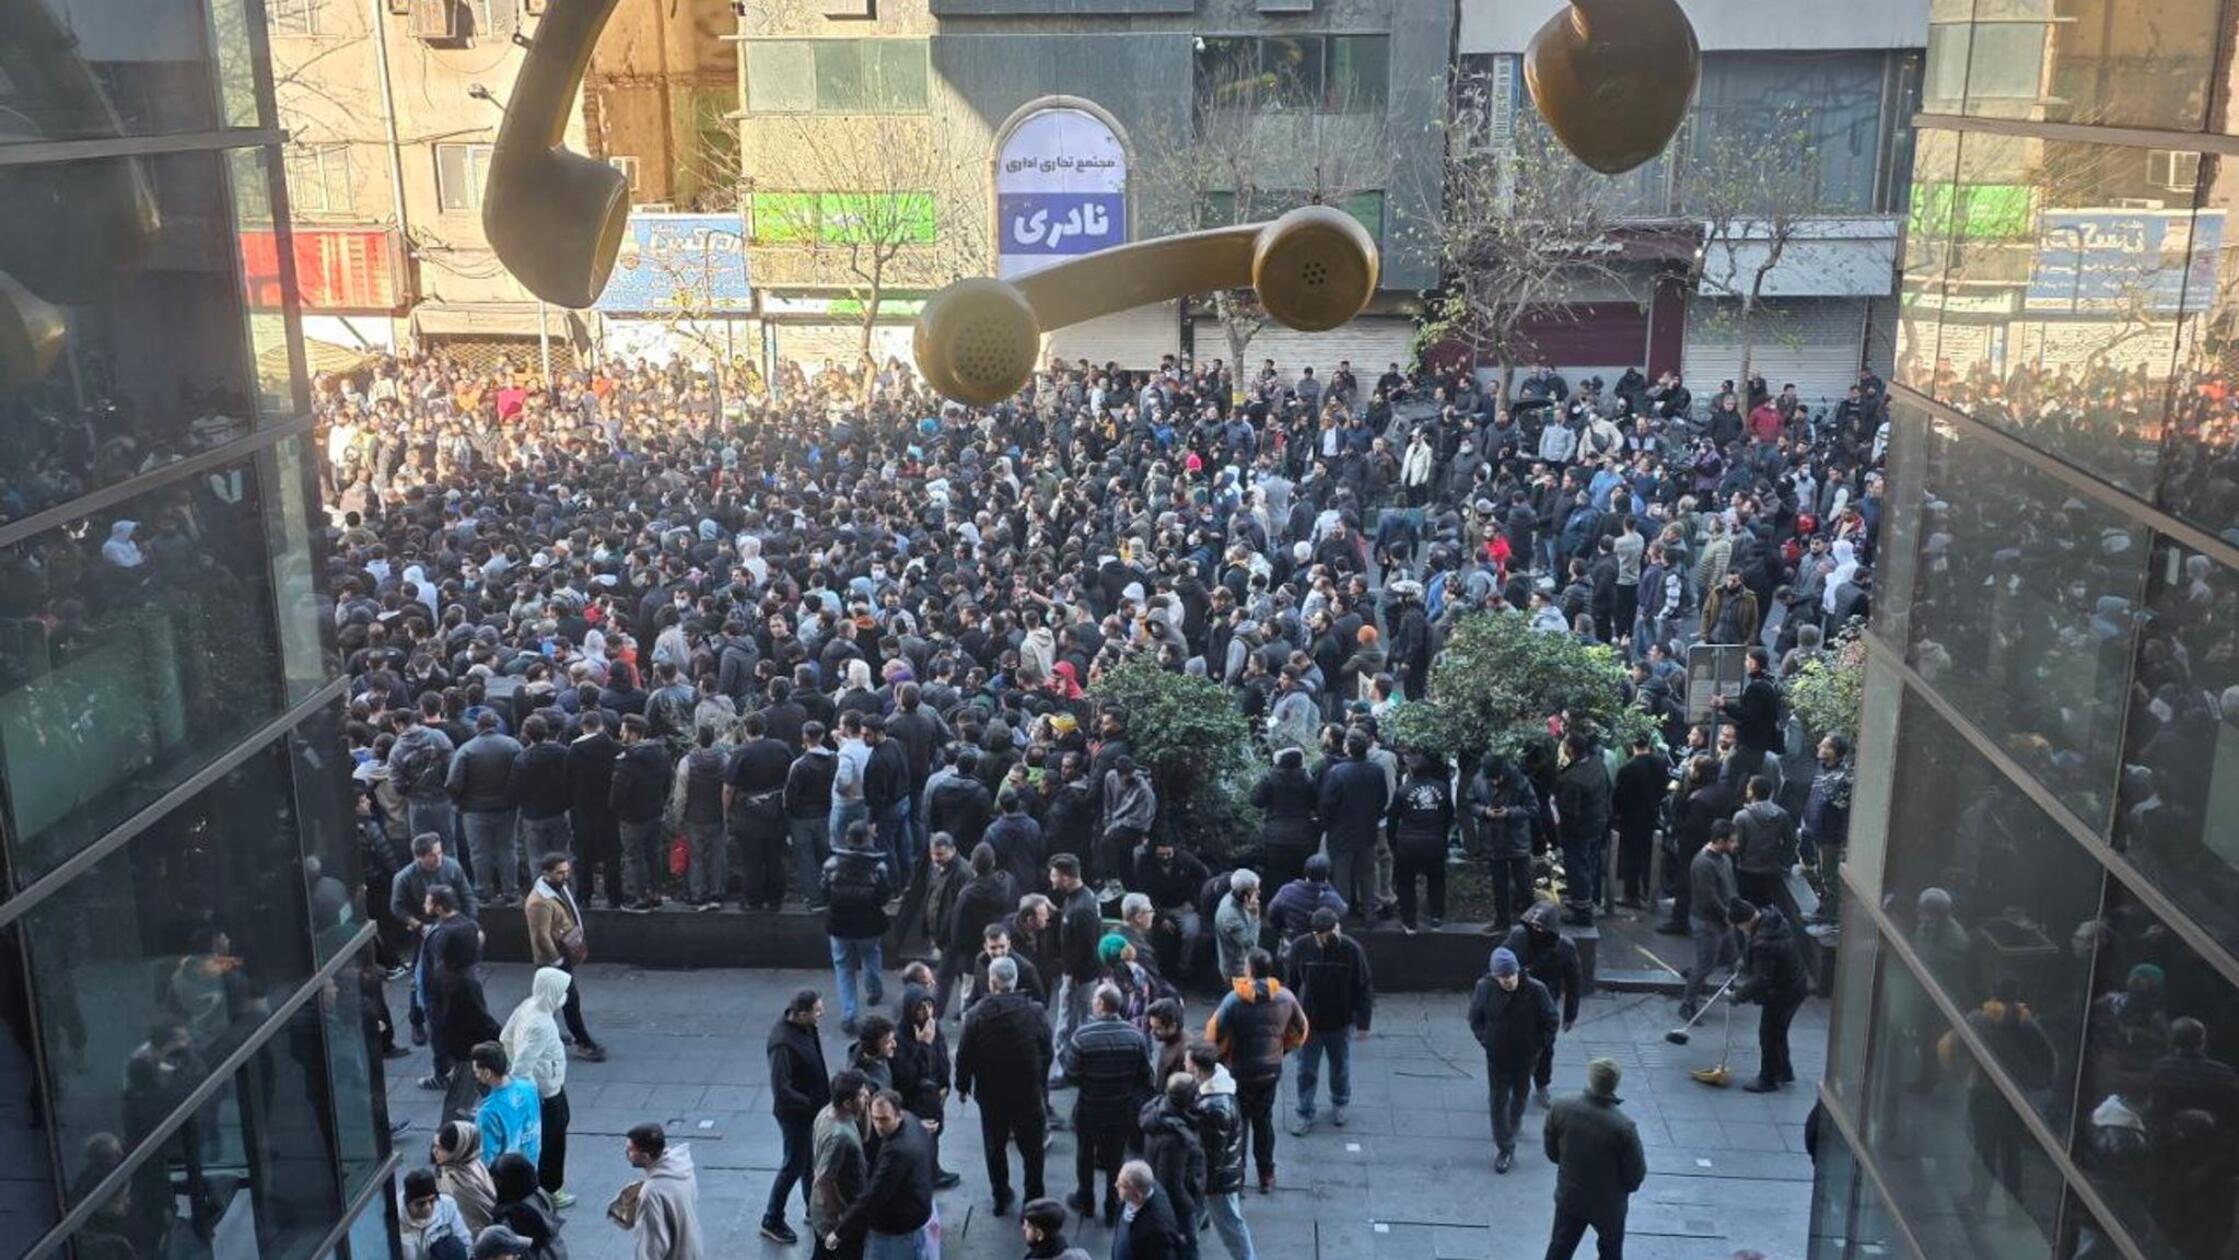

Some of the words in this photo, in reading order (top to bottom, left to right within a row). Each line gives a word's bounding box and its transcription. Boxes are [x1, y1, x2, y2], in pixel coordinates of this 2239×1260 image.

[1006, 156, 1038, 173] اداری
[1040, 155, 1075, 173] تجاری
[1076, 155, 1115, 173] مجتمع
[1014, 203, 1108, 248] نادری
